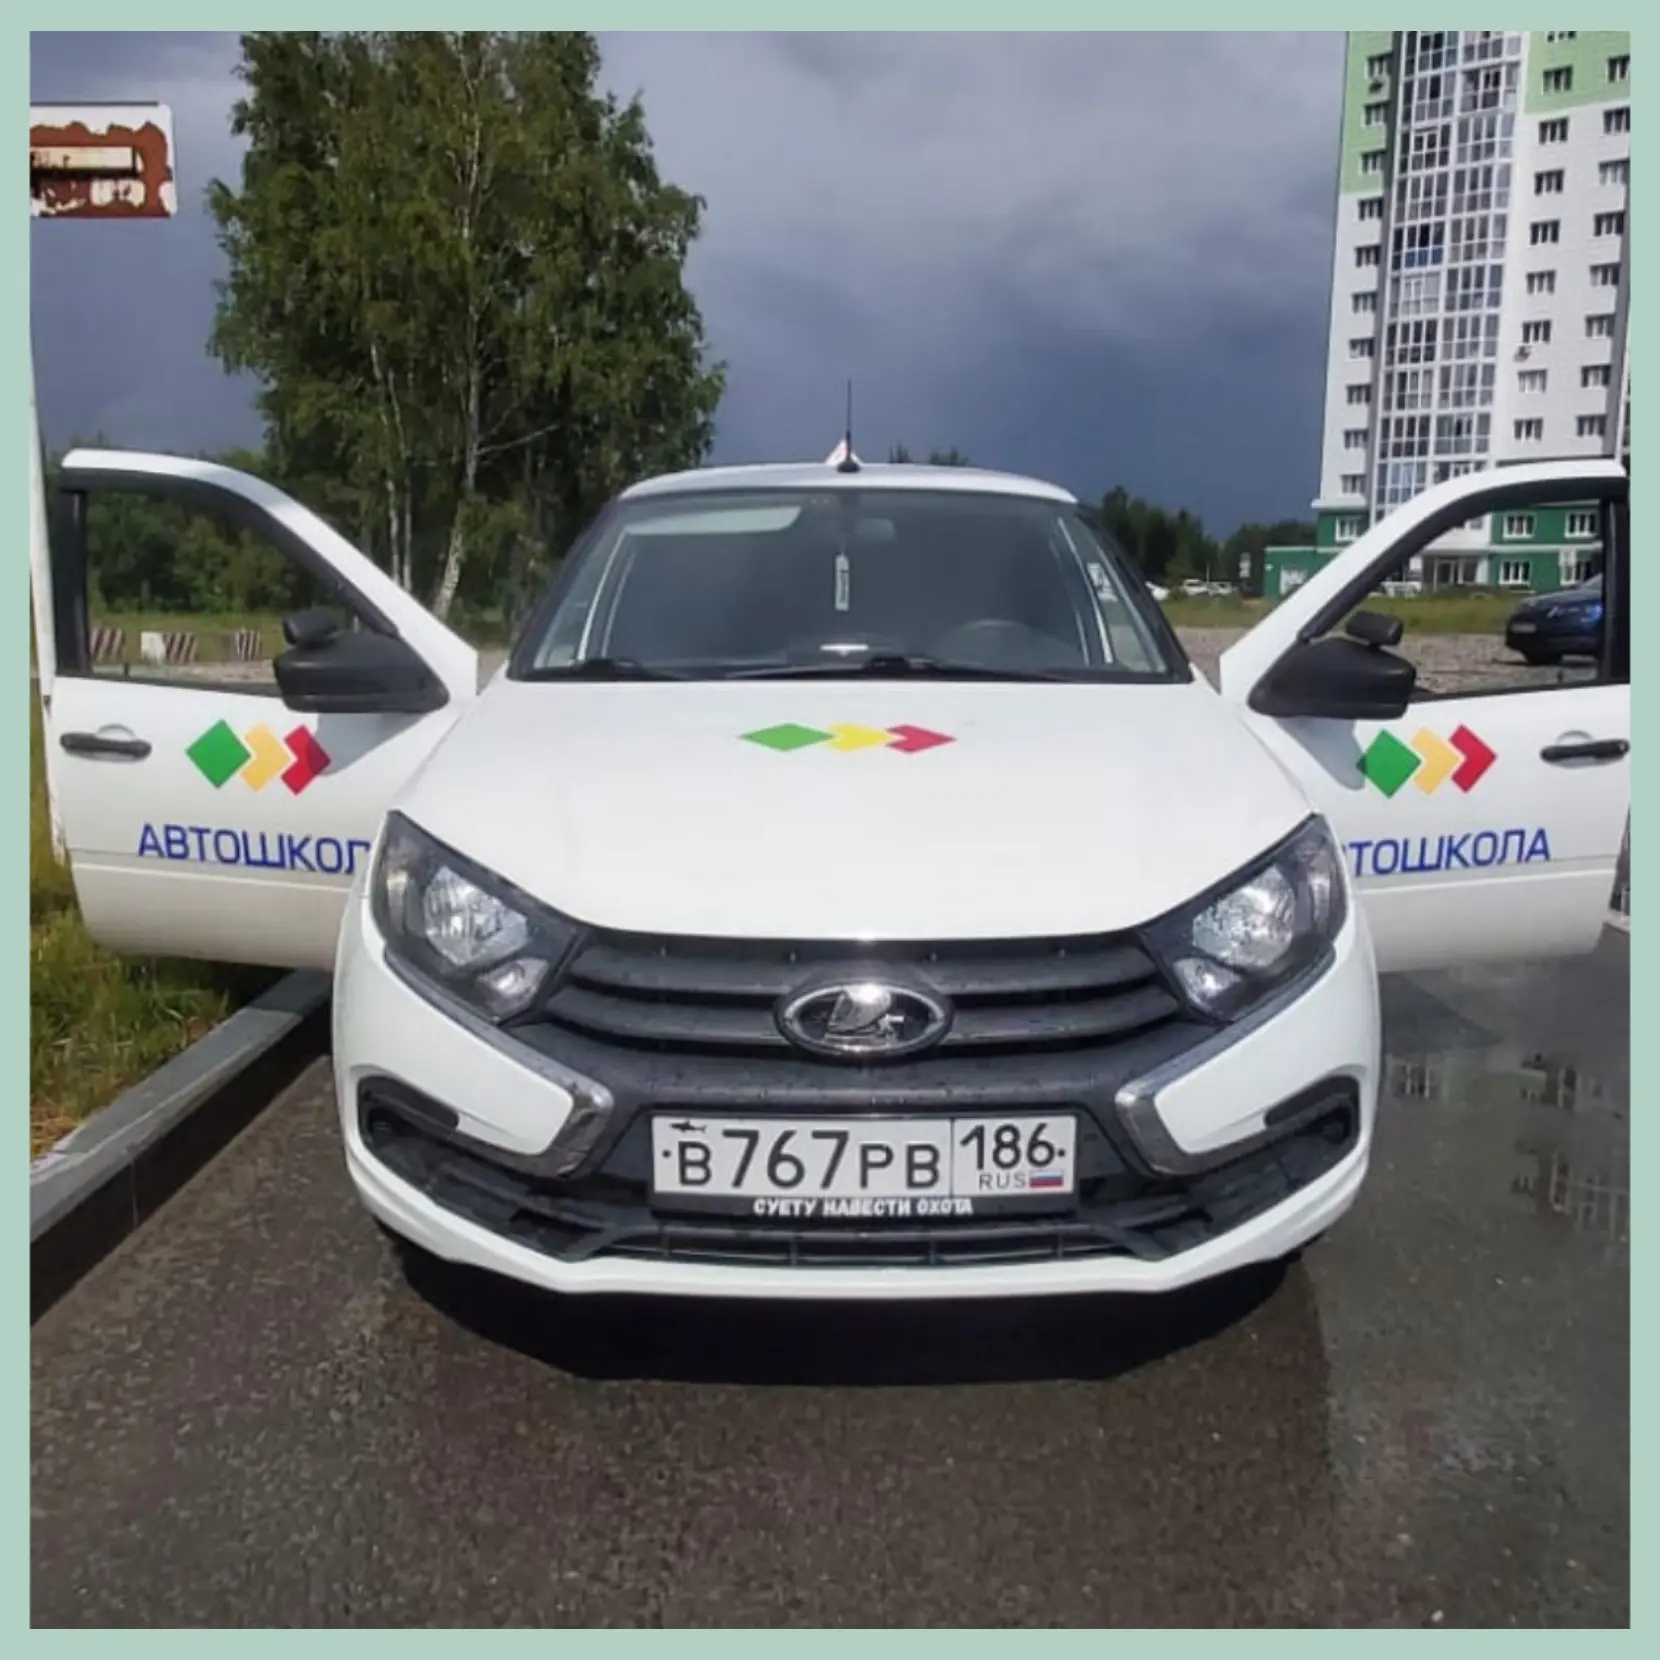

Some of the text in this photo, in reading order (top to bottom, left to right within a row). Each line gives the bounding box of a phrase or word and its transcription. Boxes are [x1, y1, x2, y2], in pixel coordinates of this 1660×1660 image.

[1342, 828, 1551, 877] ТОШКОЛА
[960, 1122, 1055, 1170] 186
[979, 1171, 1027, 1190] RUS
[753, 1197, 974, 1217] СУЕТУ НАВЕСТИ ОХОТА
